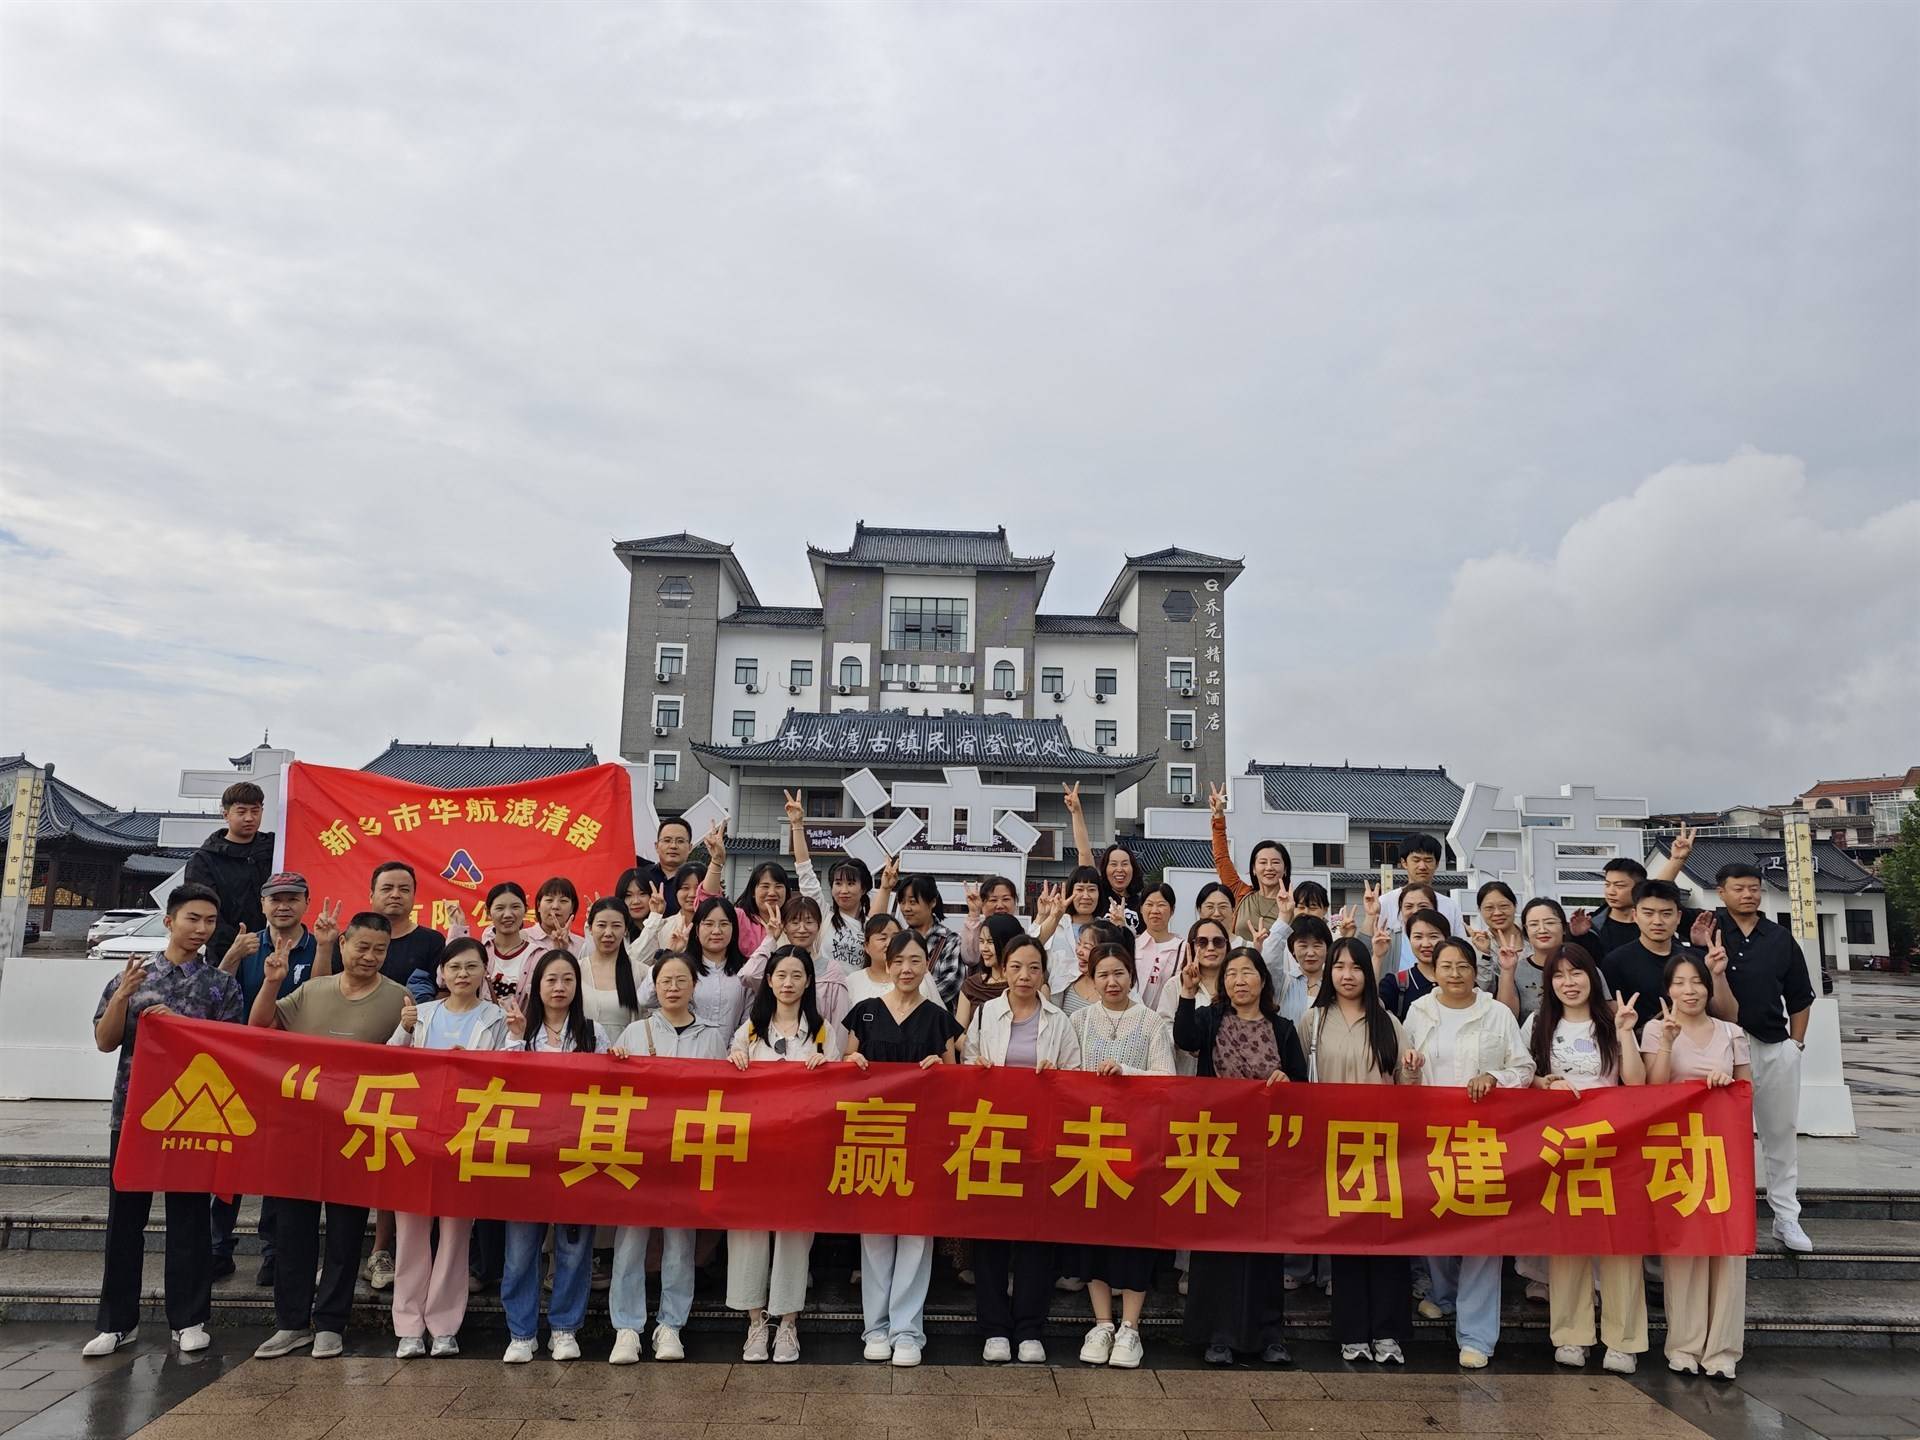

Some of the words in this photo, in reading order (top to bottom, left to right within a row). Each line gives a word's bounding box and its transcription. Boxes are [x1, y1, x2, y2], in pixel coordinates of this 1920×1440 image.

[1203, 598, 1222, 731] 乔元精品酒店
[779, 729, 1067, 758] 赤水湾古镇民宿登记处
[318, 798, 603, 856] 新乡市华航滤清器
[280, 1063, 752, 1191] “乐在其中
[827, 1096, 1733, 1219] 赢在未来”团建活动
